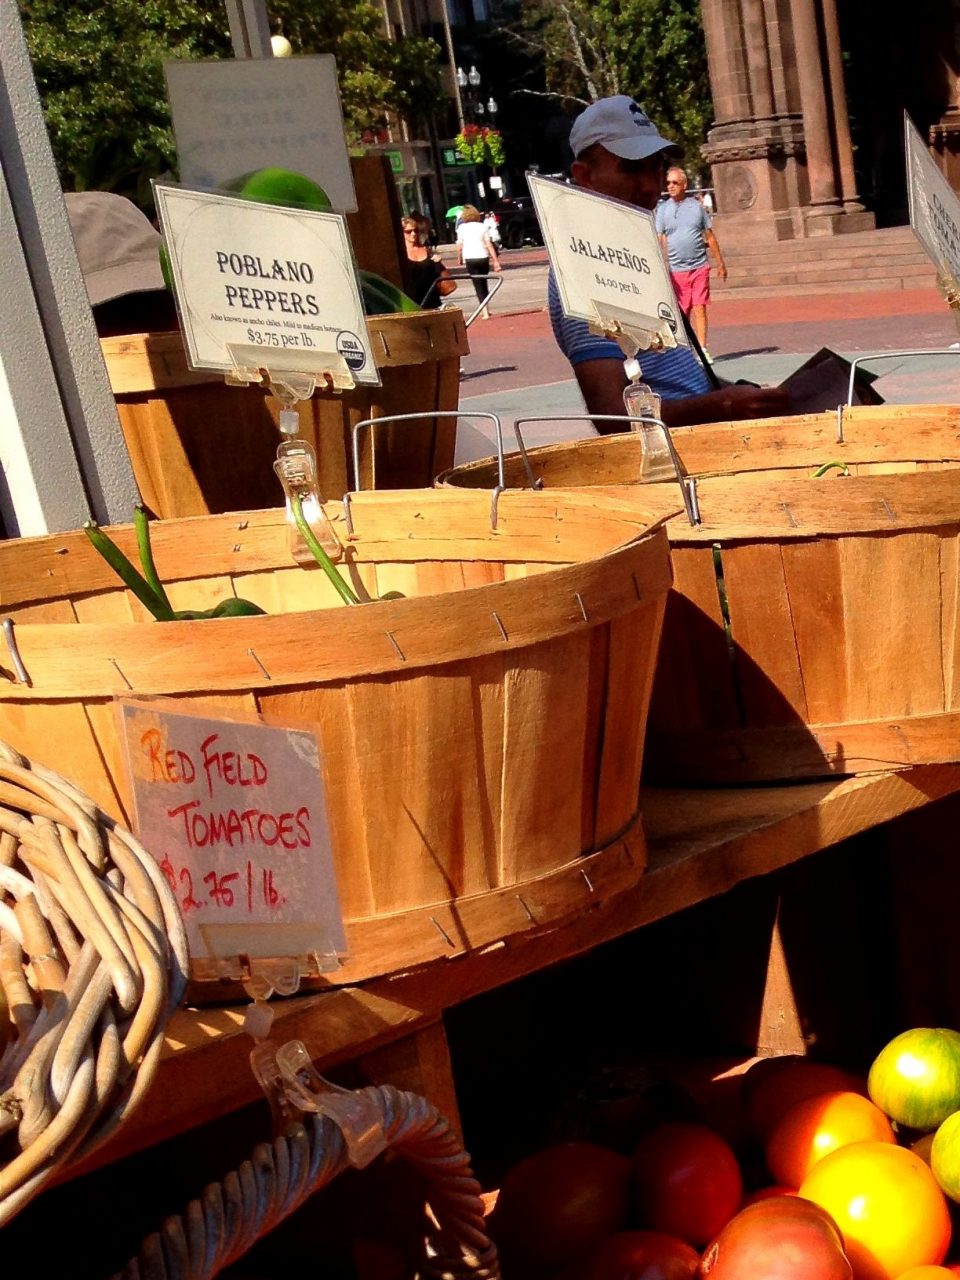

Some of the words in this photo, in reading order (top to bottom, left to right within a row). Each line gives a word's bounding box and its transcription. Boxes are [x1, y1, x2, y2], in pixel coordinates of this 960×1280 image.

[216, 251, 314, 284] POBLANO
[570, 237, 651, 275] JALAPEÑOS
[595, 273, 618, 288] $4.00
[619, 281, 632, 293] per
[225, 285, 320, 316] PEPPERS
[247, 328, 279, 347] $3.75
[281, 334, 298, 348] per
[300, 332, 316, 348] lb.
[342, 340, 359, 350] USDA
[140, 727, 196, 785] RED
[200, 733, 268, 799] FIELD
[168, 800, 311, 849] TOMATOES
